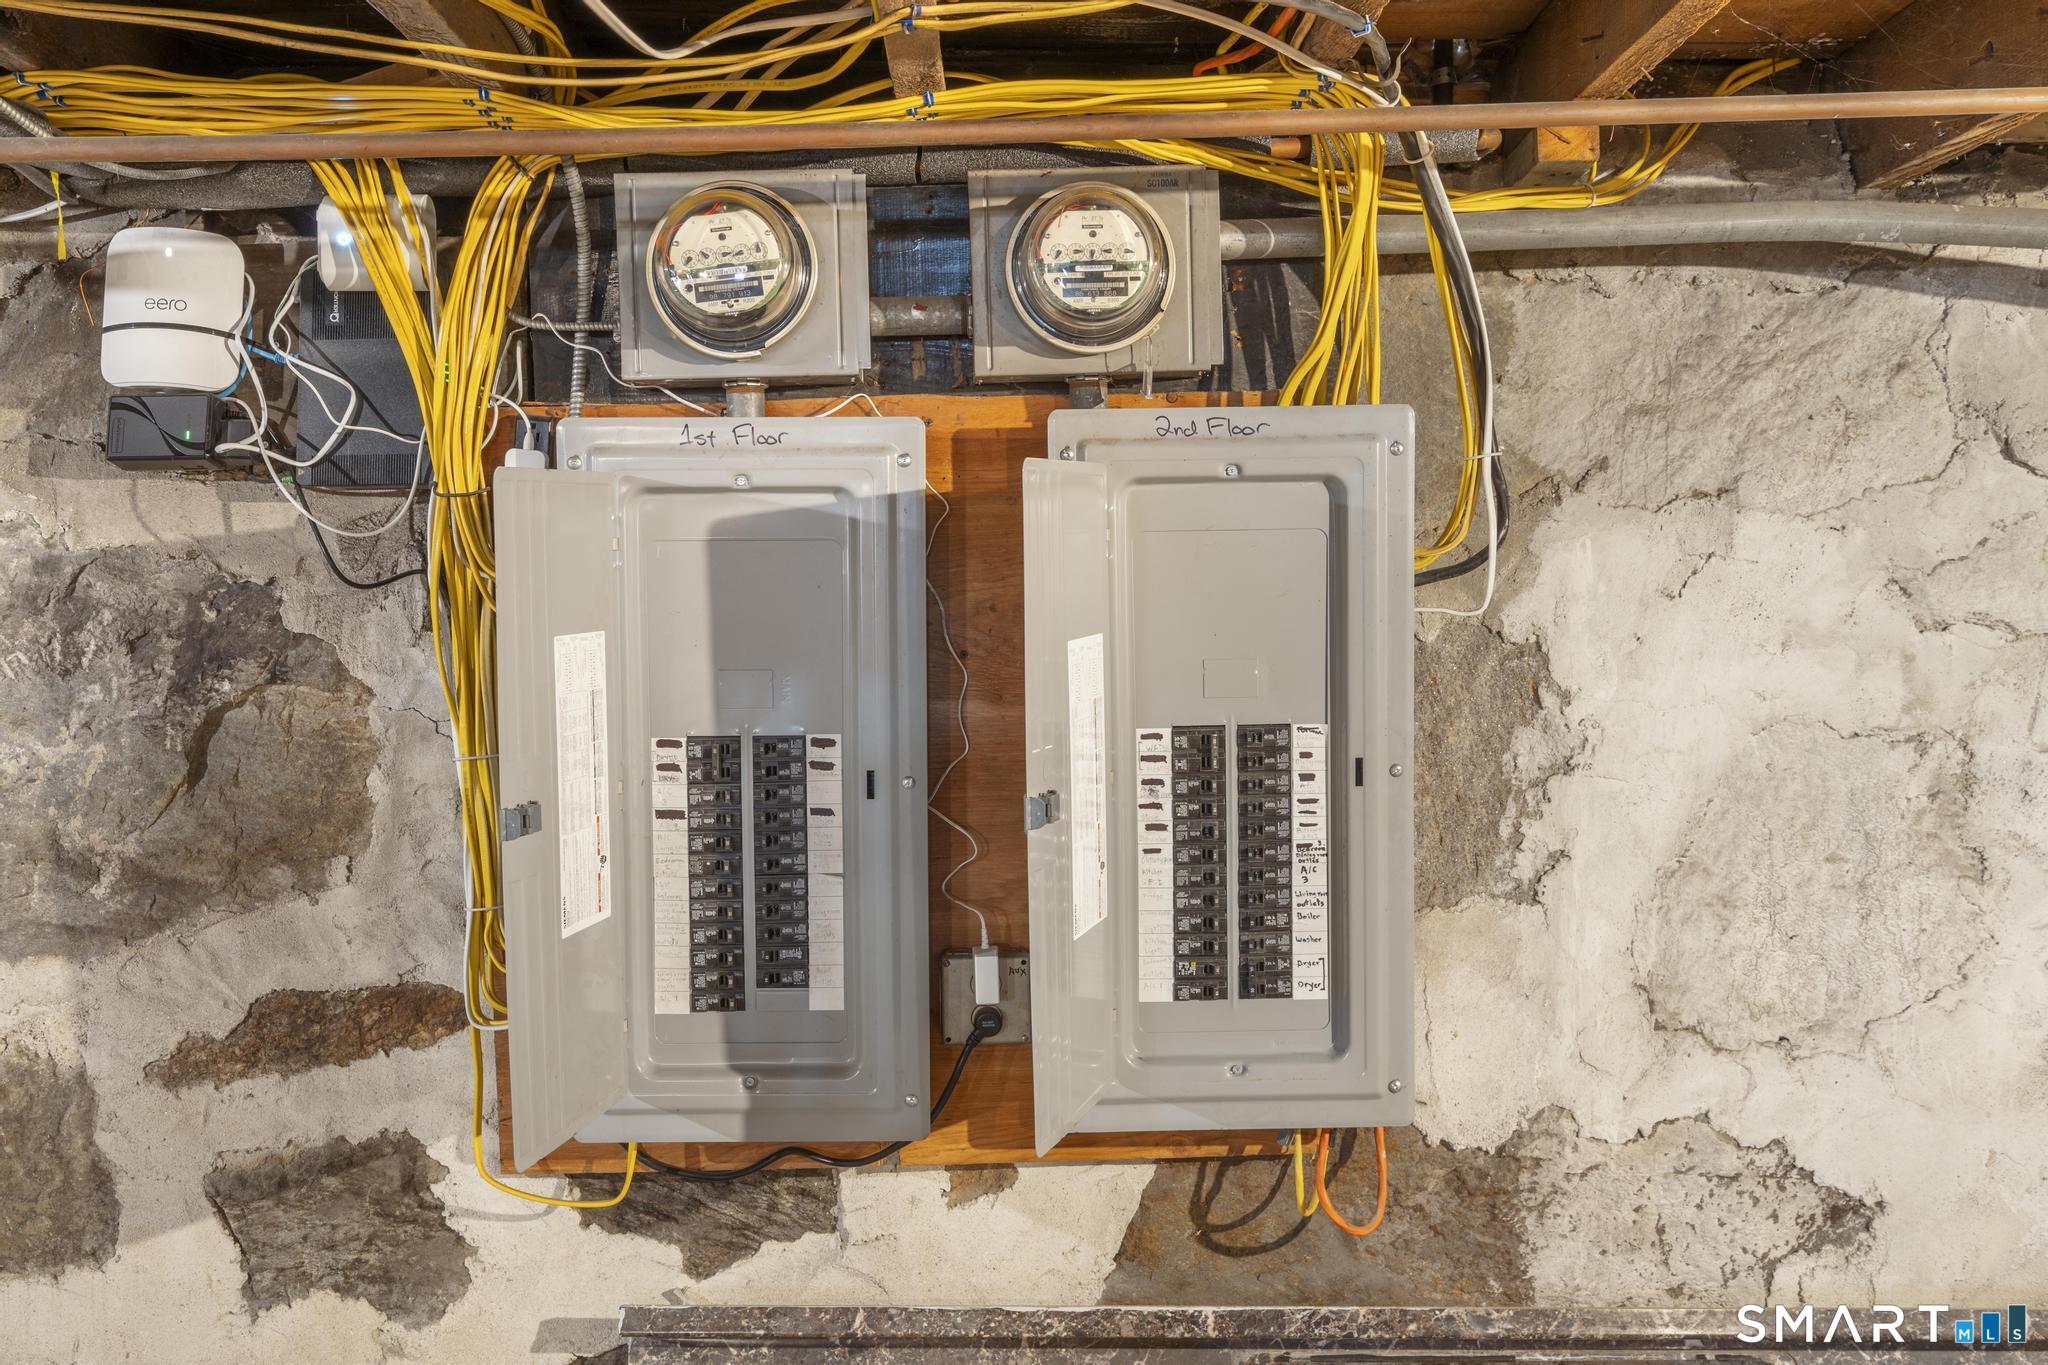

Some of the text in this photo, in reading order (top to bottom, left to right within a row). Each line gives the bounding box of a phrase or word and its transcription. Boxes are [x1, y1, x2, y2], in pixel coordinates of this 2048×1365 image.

[144, 297, 187, 311] eero
[1154, 415, 1271, 438] 2nd Floor
[679, 423, 790, 448] 1st Floor
[1301, 865, 1317, 875] A/C
[1301, 875, 1309, 884] 3
[1296, 898, 1325, 908] outlets
[1296, 911, 1321, 920] Boiler
[1295, 935, 1322, 943] Washer
[1296, 959, 1321, 969] Dryer
[1297, 980, 1322, 992] Dryer
